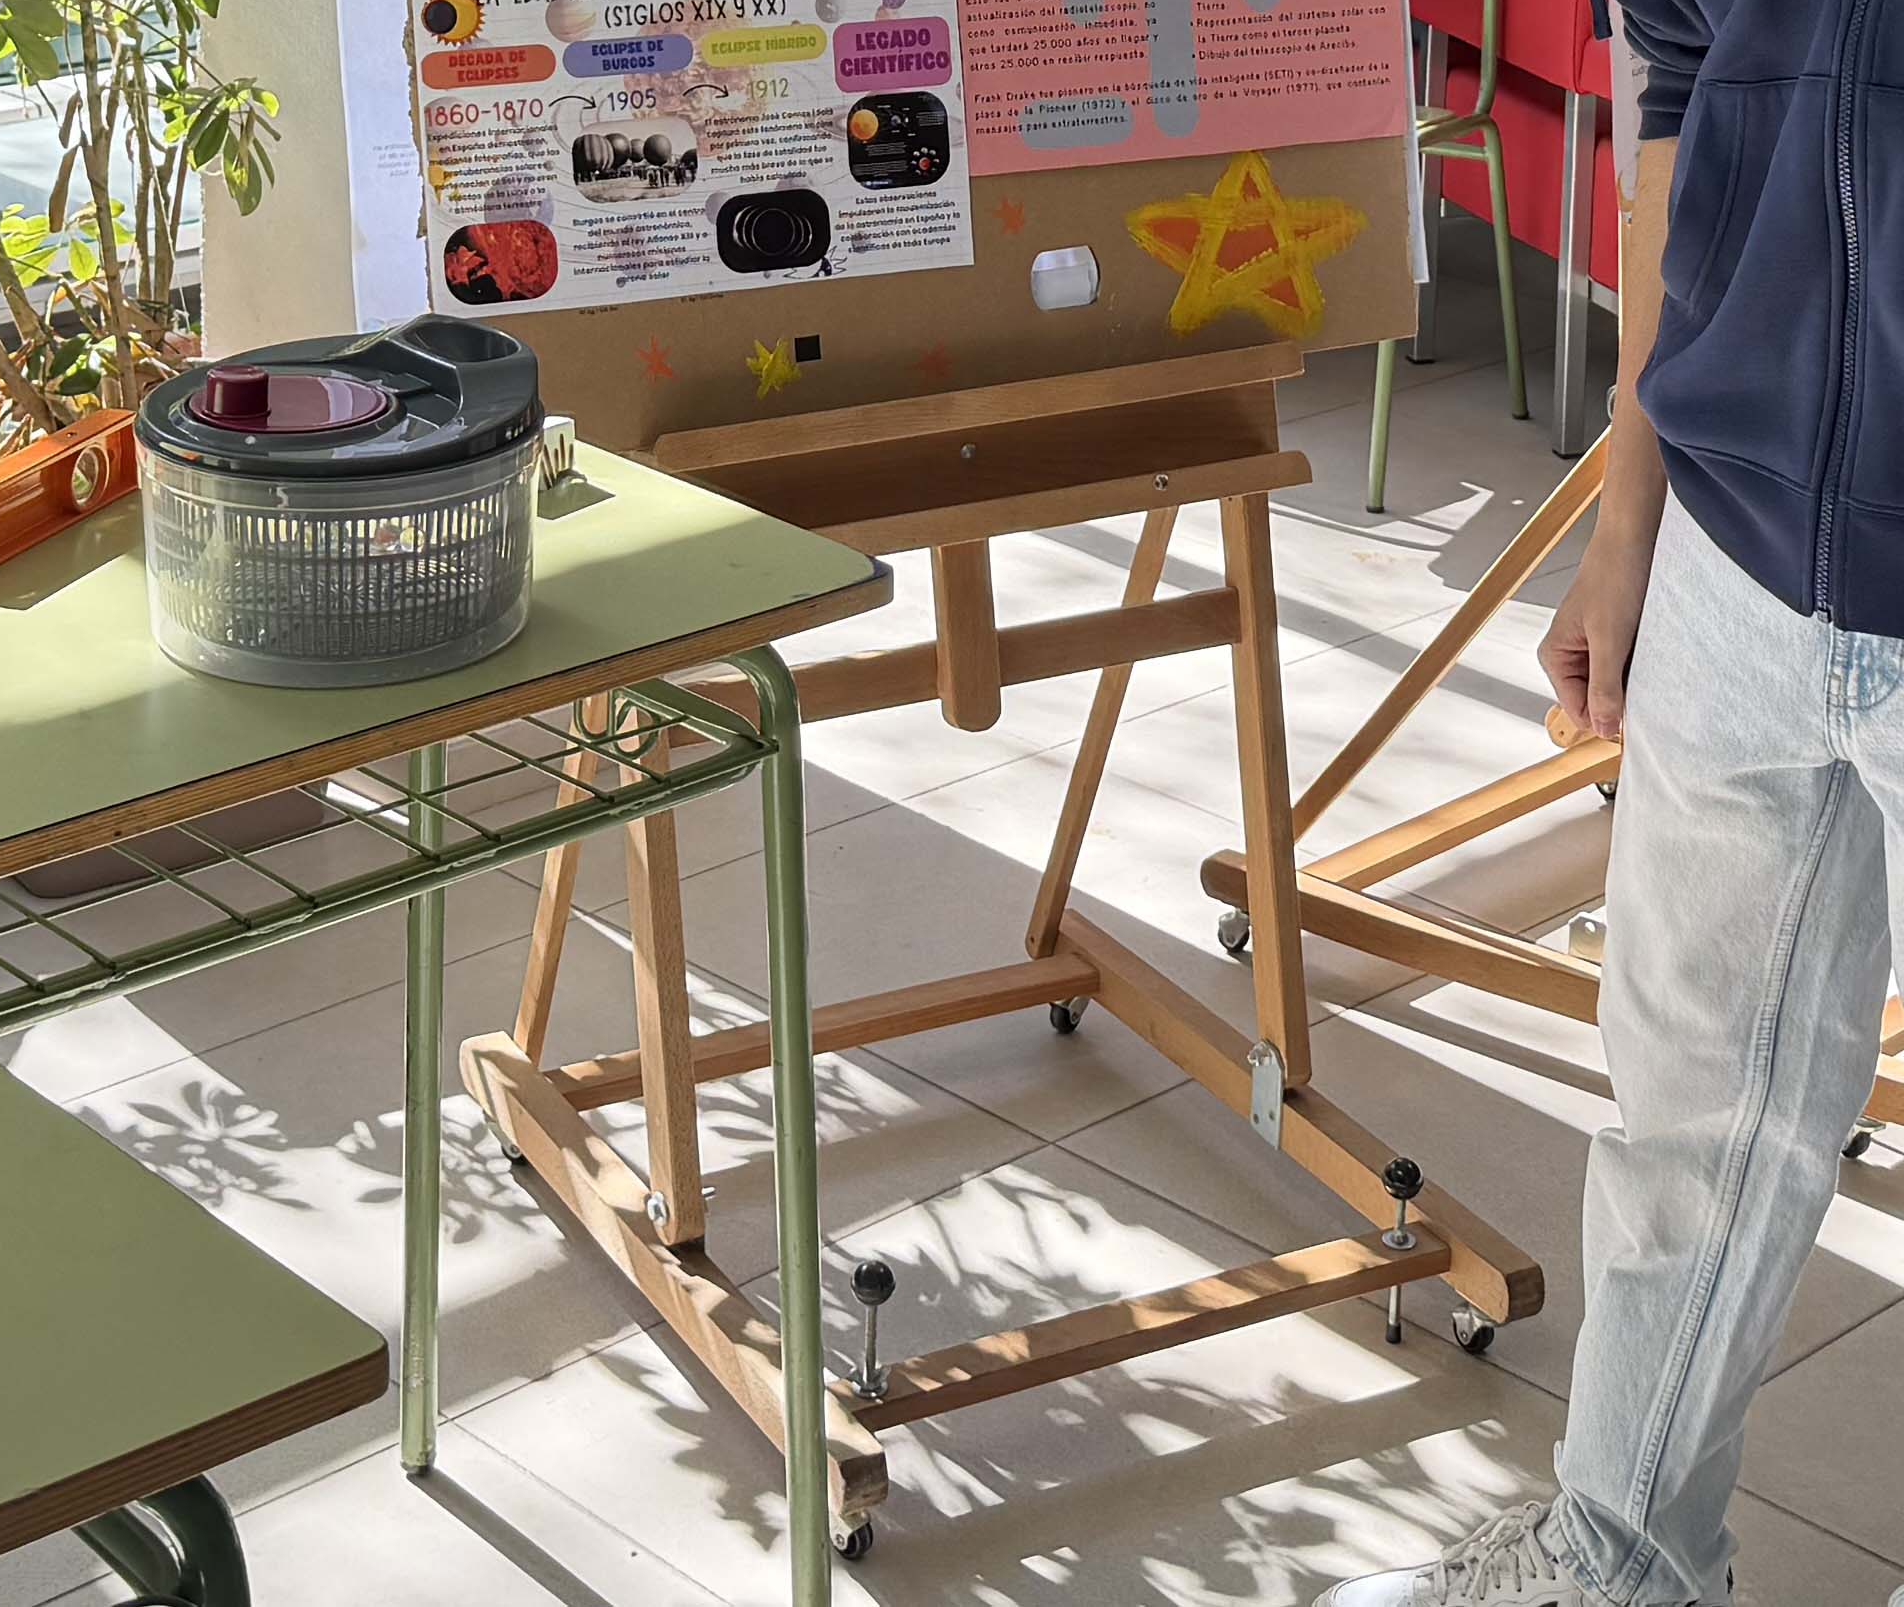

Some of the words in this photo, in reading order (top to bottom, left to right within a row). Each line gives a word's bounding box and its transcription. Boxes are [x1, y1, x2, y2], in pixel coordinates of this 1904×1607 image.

[605, 0, 685, 29] (SIGLOS
[691, 0, 726, 22] XIX
[592, 41, 643, 56] ECLIPSE
[648, 39, 664, 52] DE
[711, 40, 761, 56] ECLIPSE
[856, 28, 930, 51] LEGADO
[509, 50, 526, 63] DE
[602, 55, 655, 71] BURGOS
[840, 50, 950, 77] CIENTÍFICO
[1199, 50, 1231, 62] Dibujo
[458, 66, 520, 83] ECLIPSES
[748, 78, 789, 99] 1912
[607, 89, 656, 112] 1905
[425, 98, 544, 127] 1860-1870
